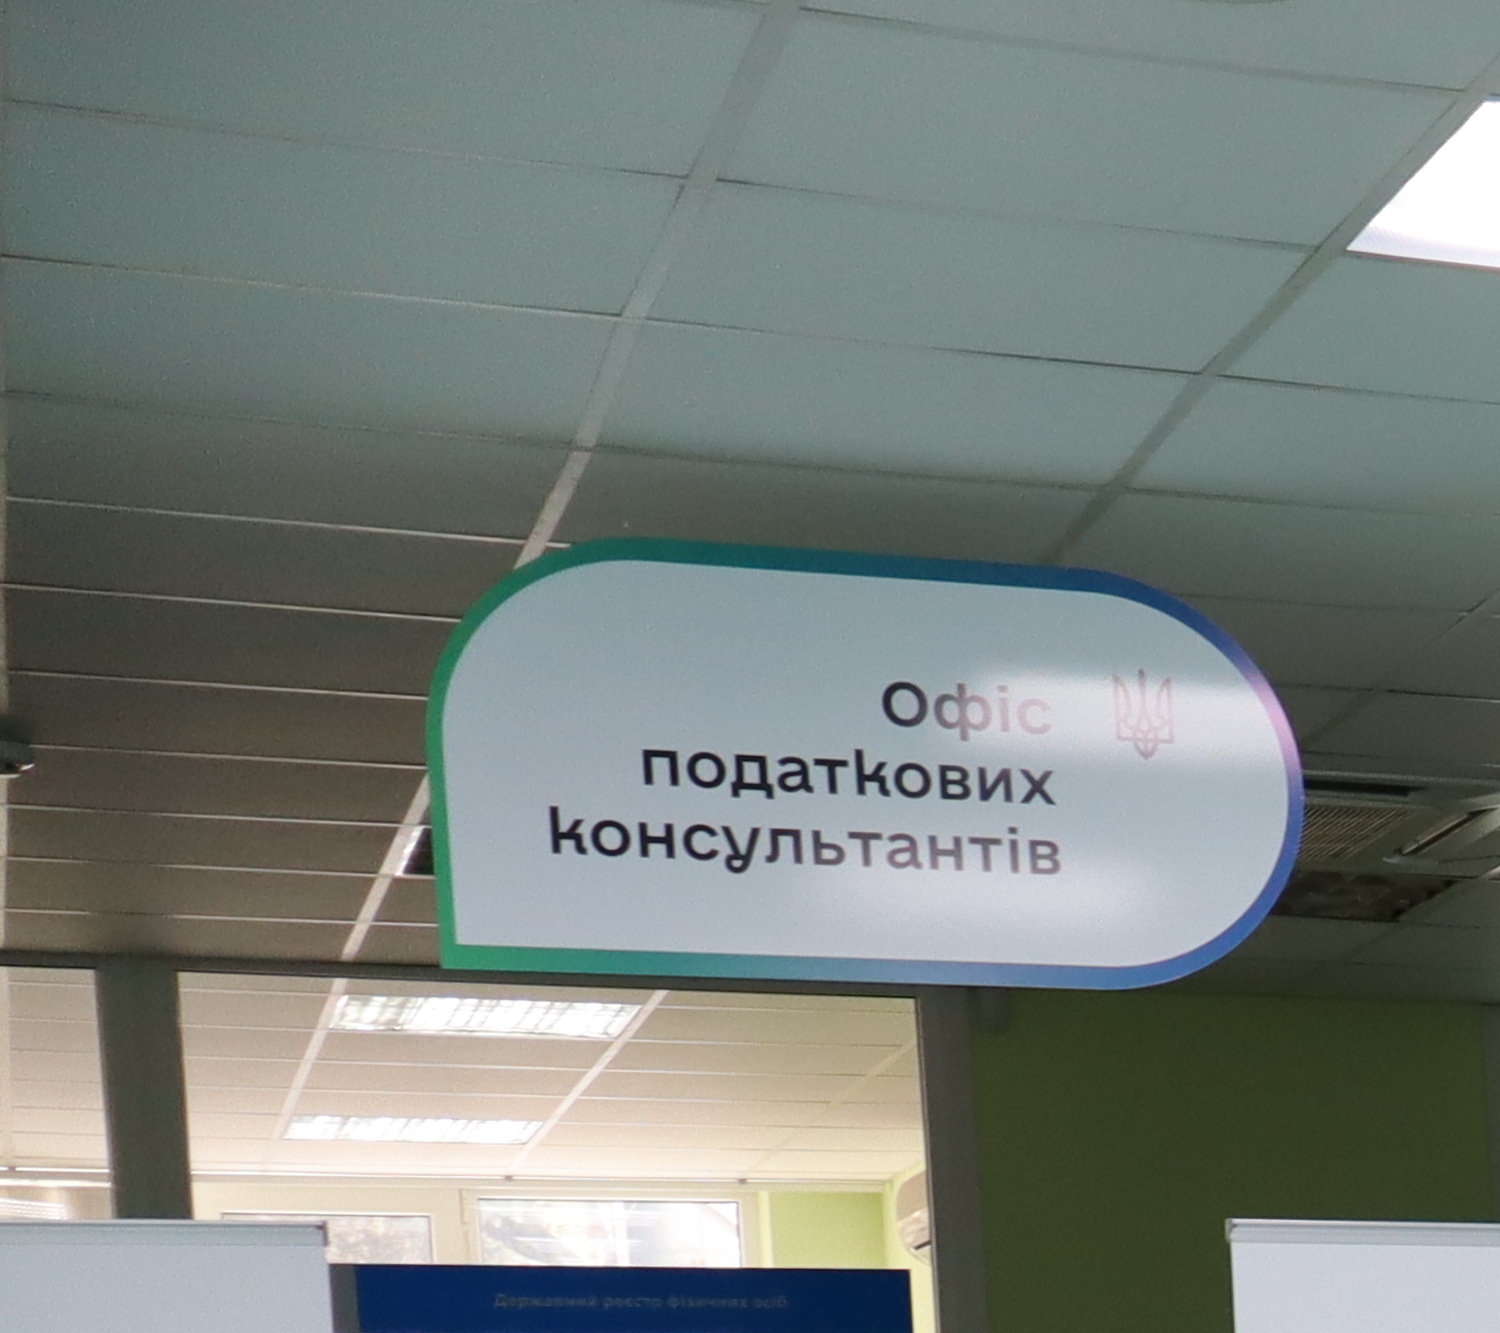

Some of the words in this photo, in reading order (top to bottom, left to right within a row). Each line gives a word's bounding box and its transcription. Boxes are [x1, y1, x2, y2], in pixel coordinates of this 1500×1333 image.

[882, 681, 1052, 741] Офіс
[642, 749, 1056, 805] податкових
[549, 806, 1061, 873] консультантів
